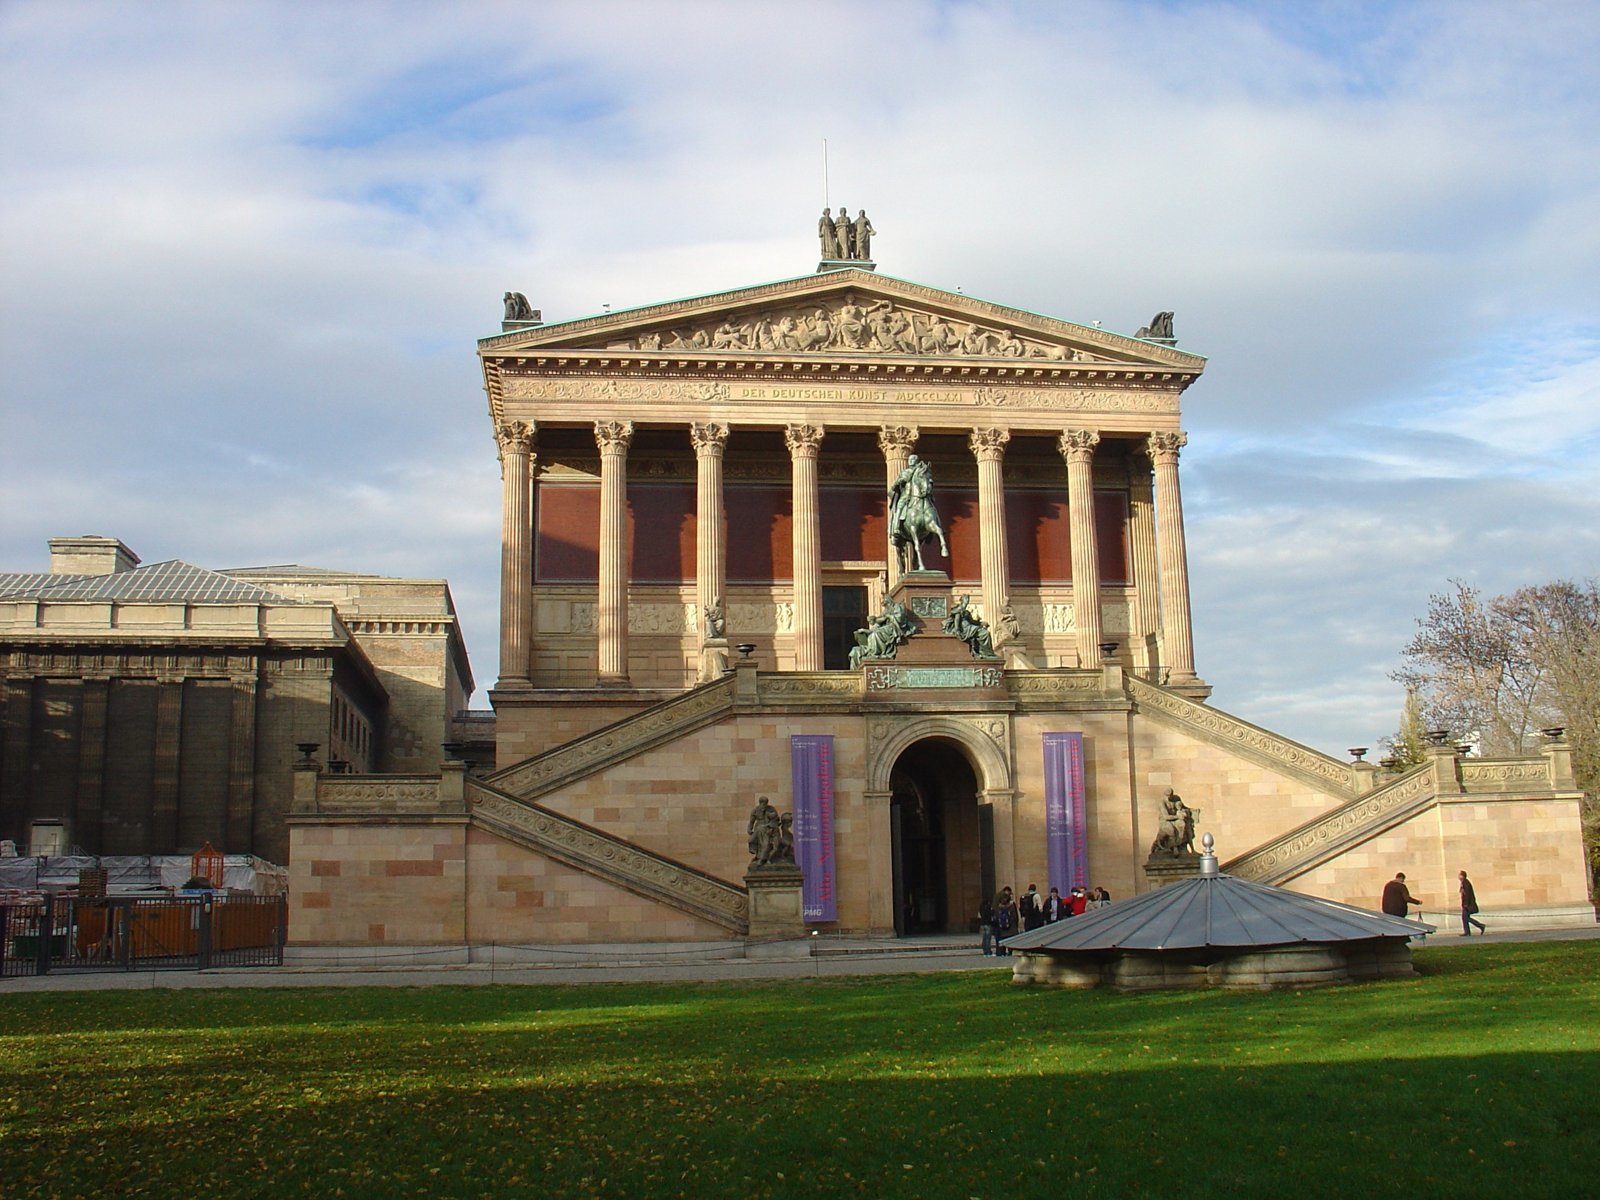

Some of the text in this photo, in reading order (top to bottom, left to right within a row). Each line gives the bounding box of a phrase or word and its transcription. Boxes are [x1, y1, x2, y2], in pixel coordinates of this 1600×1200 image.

[742, 388, 962, 402] DER DEUTSCHEN KUNST MDCCCLXXI
